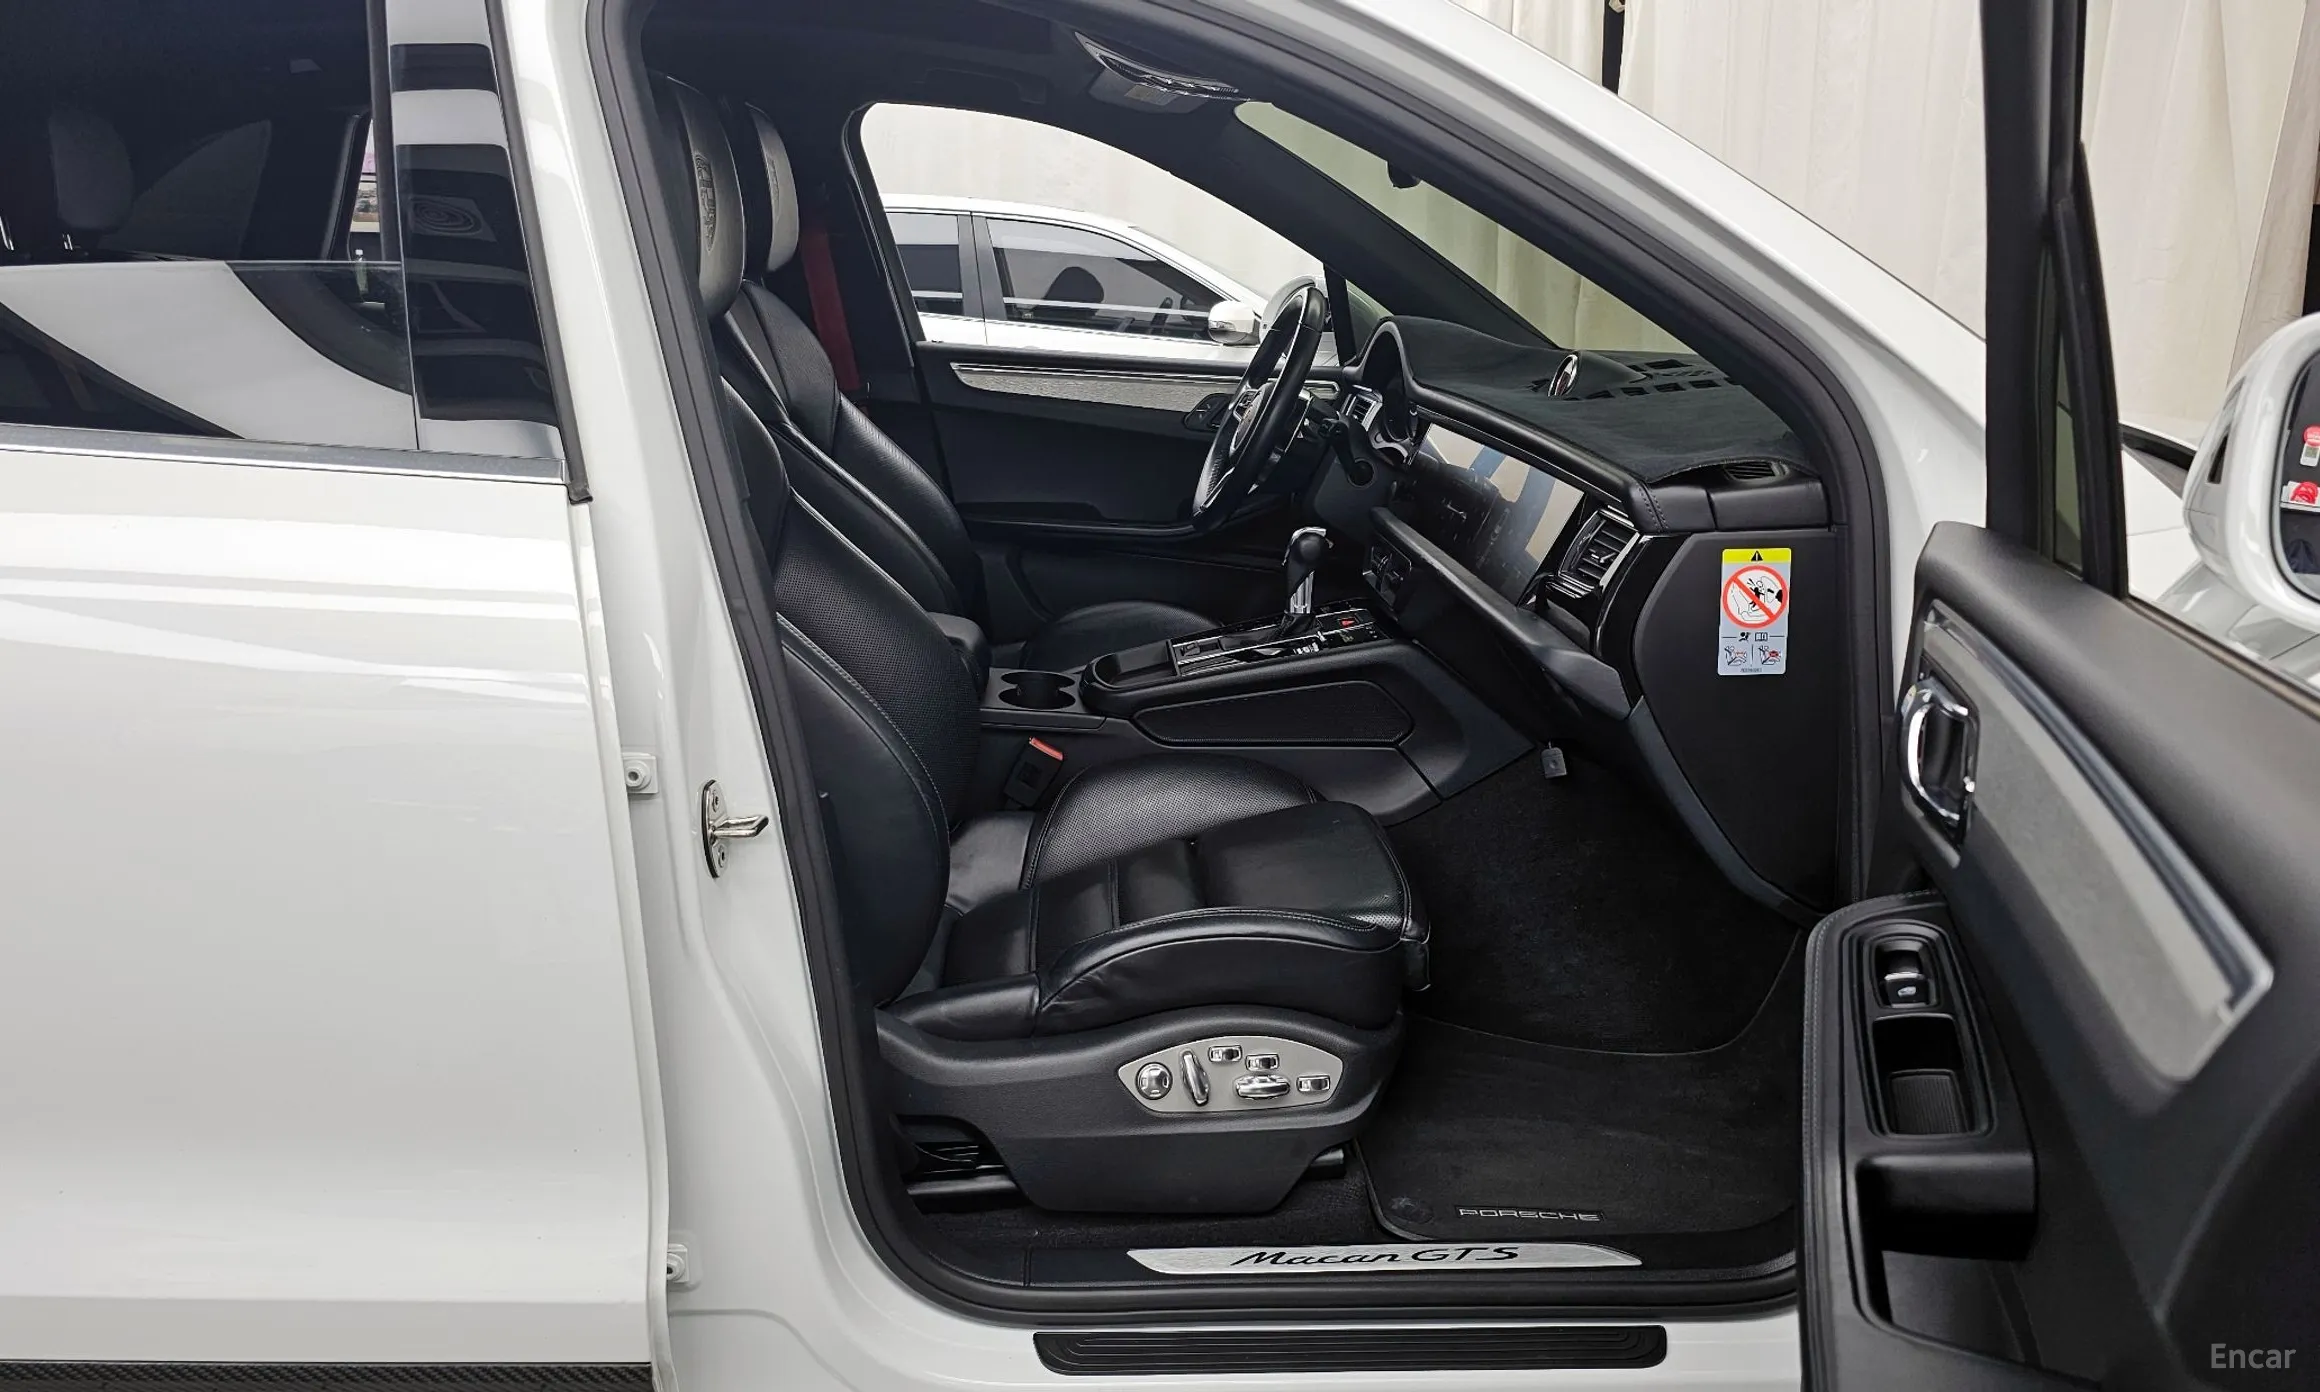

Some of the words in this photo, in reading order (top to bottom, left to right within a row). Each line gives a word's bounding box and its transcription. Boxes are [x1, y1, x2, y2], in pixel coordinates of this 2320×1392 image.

[1458, 1208, 1600, 1221] PORSCHE
[1230, 1252, 1401, 1266] Macan
[1411, 1247, 1519, 1262] GTS
